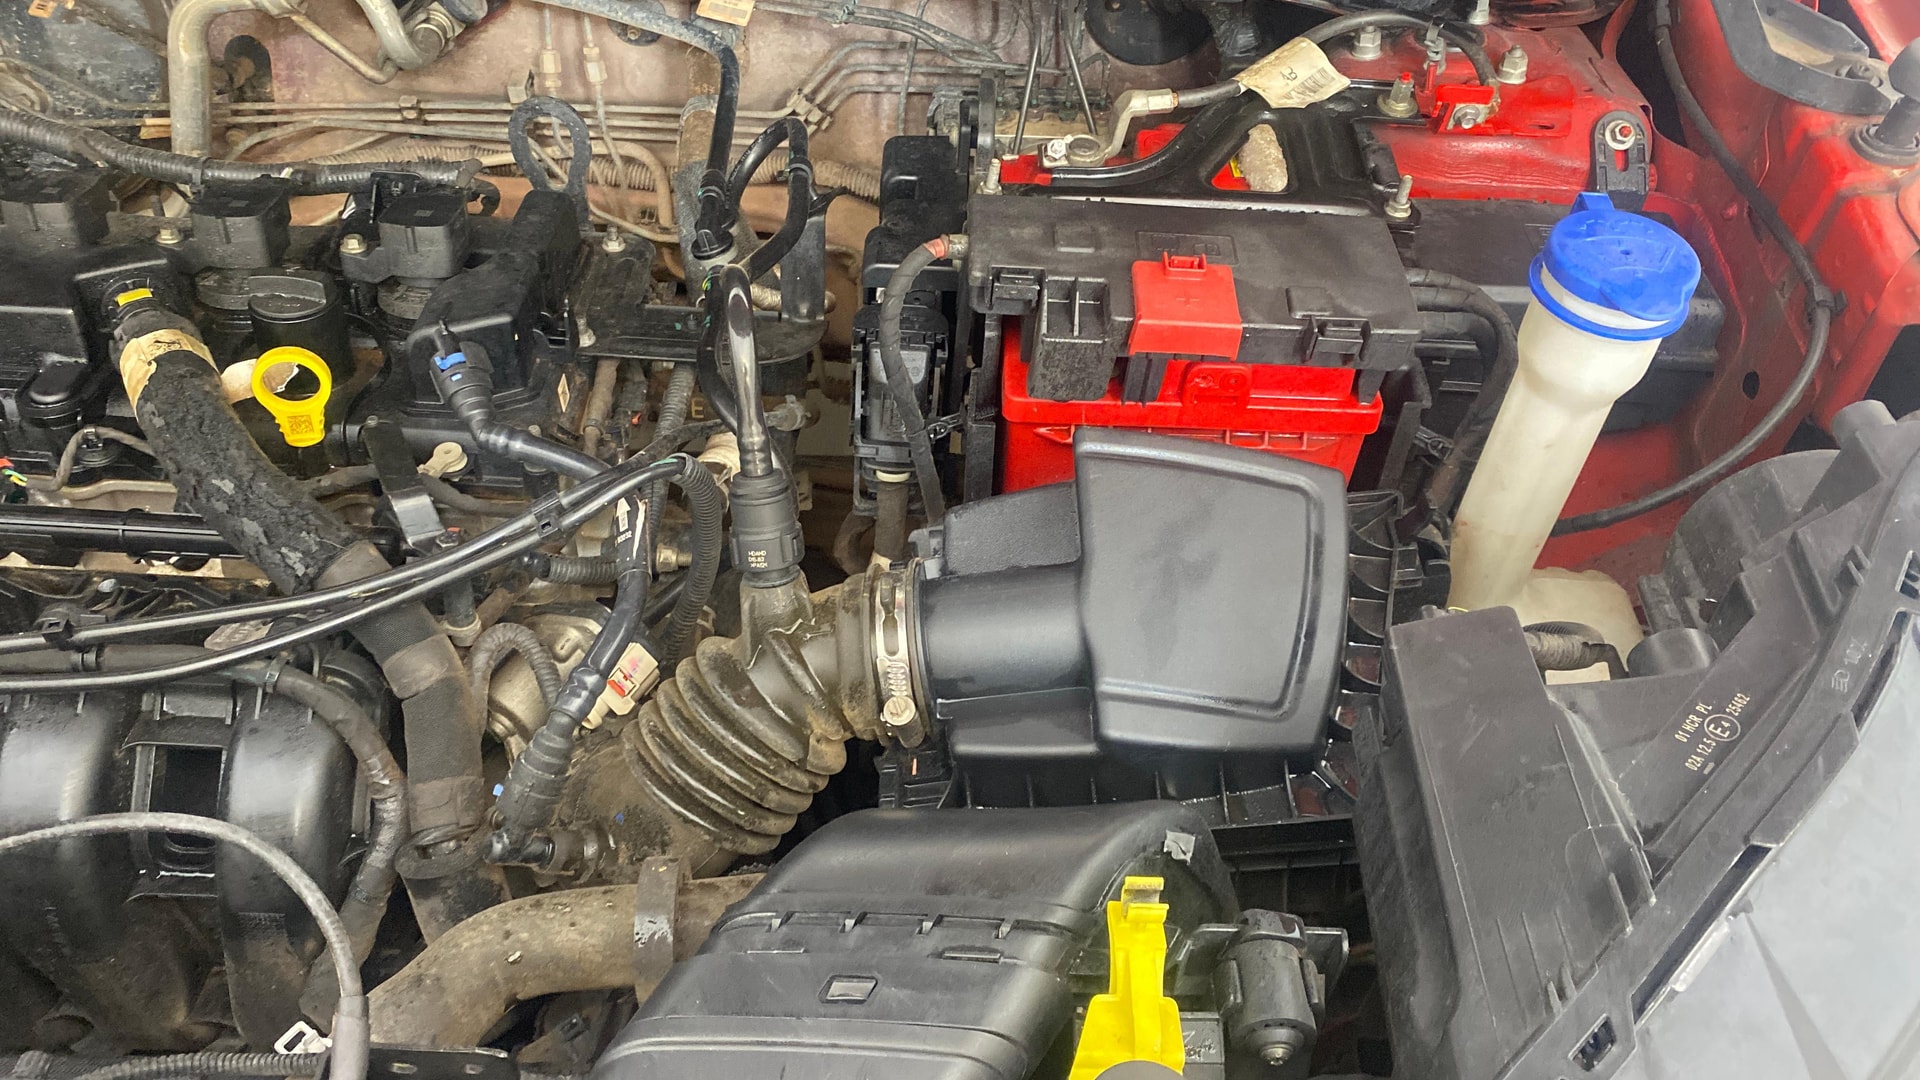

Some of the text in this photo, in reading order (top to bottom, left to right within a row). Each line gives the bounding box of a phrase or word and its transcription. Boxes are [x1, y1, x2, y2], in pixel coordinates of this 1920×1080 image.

[1725, 692, 1751, 716] 25462
[1674, 703, 1713, 743] 01 HCR PL
[1684, 737, 1717, 771] 02A 12.5
